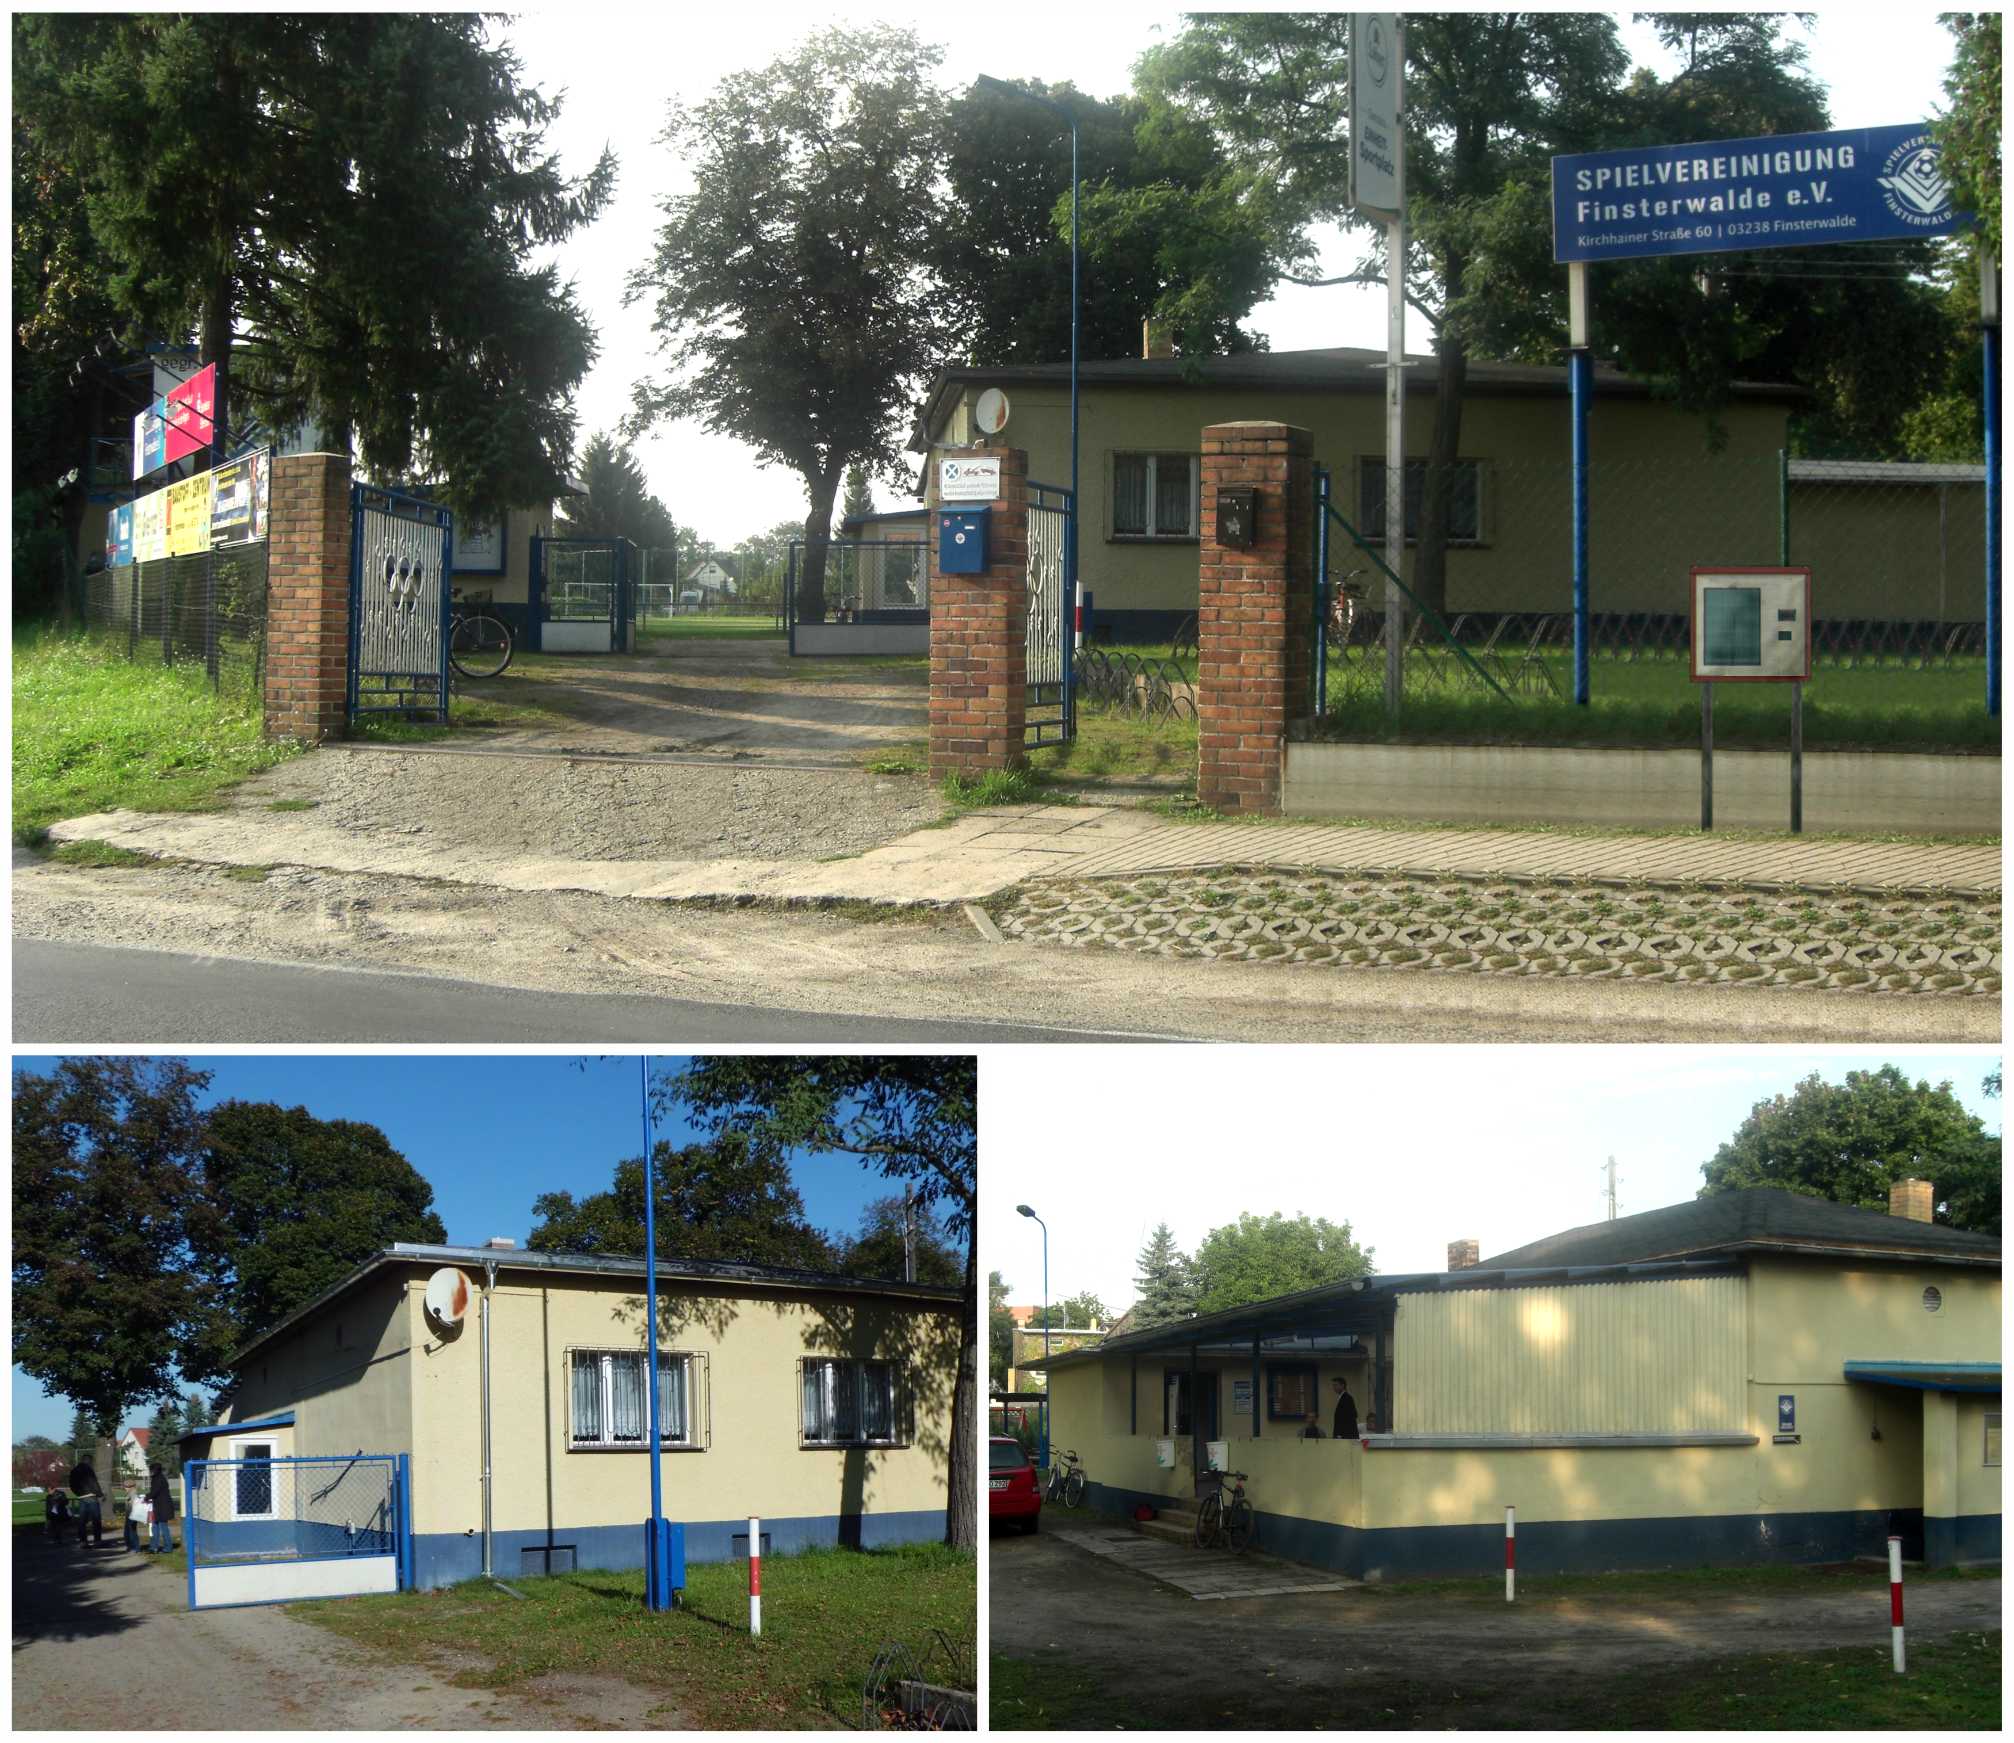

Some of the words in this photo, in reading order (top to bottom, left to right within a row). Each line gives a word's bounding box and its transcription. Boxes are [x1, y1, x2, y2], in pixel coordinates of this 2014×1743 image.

[1576, 145, 1855, 191] SPIELVEREINIGUNG
[1577, 187, 1771, 222] Finsterwalde
[1786, 181, 1832, 205] e.V.
[1883, 193, 1953, 226] FINSTERWALD
[1578, 231, 1648, 247] Kirchhainer
[1652, 227, 1692, 241] Straße
[1695, 225, 1712, 238] 60
[1727, 221, 1770, 235] 03238
[1774, 214, 1857, 232] Finsterwalde
